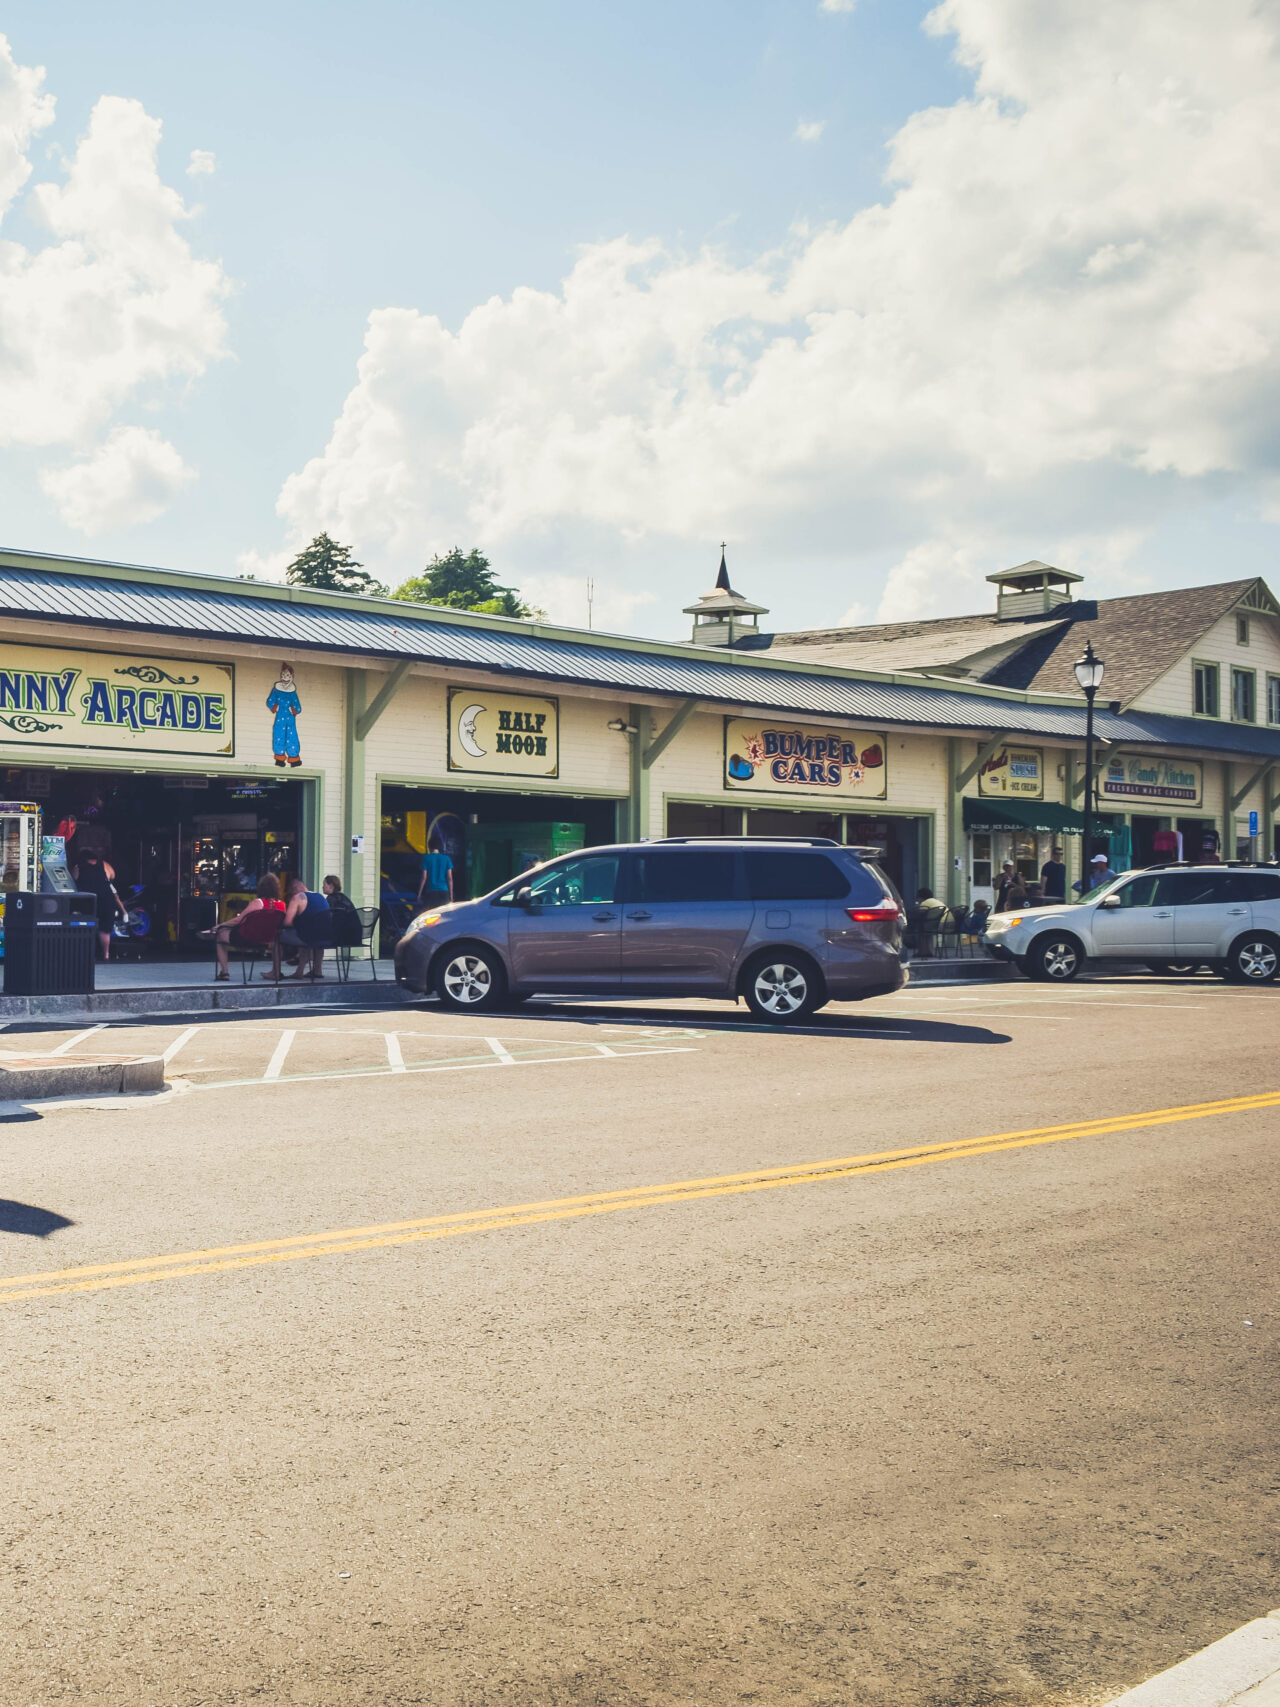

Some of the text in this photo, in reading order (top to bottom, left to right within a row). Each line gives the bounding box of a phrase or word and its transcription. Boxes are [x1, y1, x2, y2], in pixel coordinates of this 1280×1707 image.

[83, 680, 225, 732] ARCADE
[498, 711, 546, 733] HALF
[496, 733, 548, 756] MOON
[762, 730, 858, 766] BUMPER
[771, 757, 841, 786] CARS
[1107, 784, 1139, 793] FRESHLY
[1143, 787, 1161, 796] MADE
